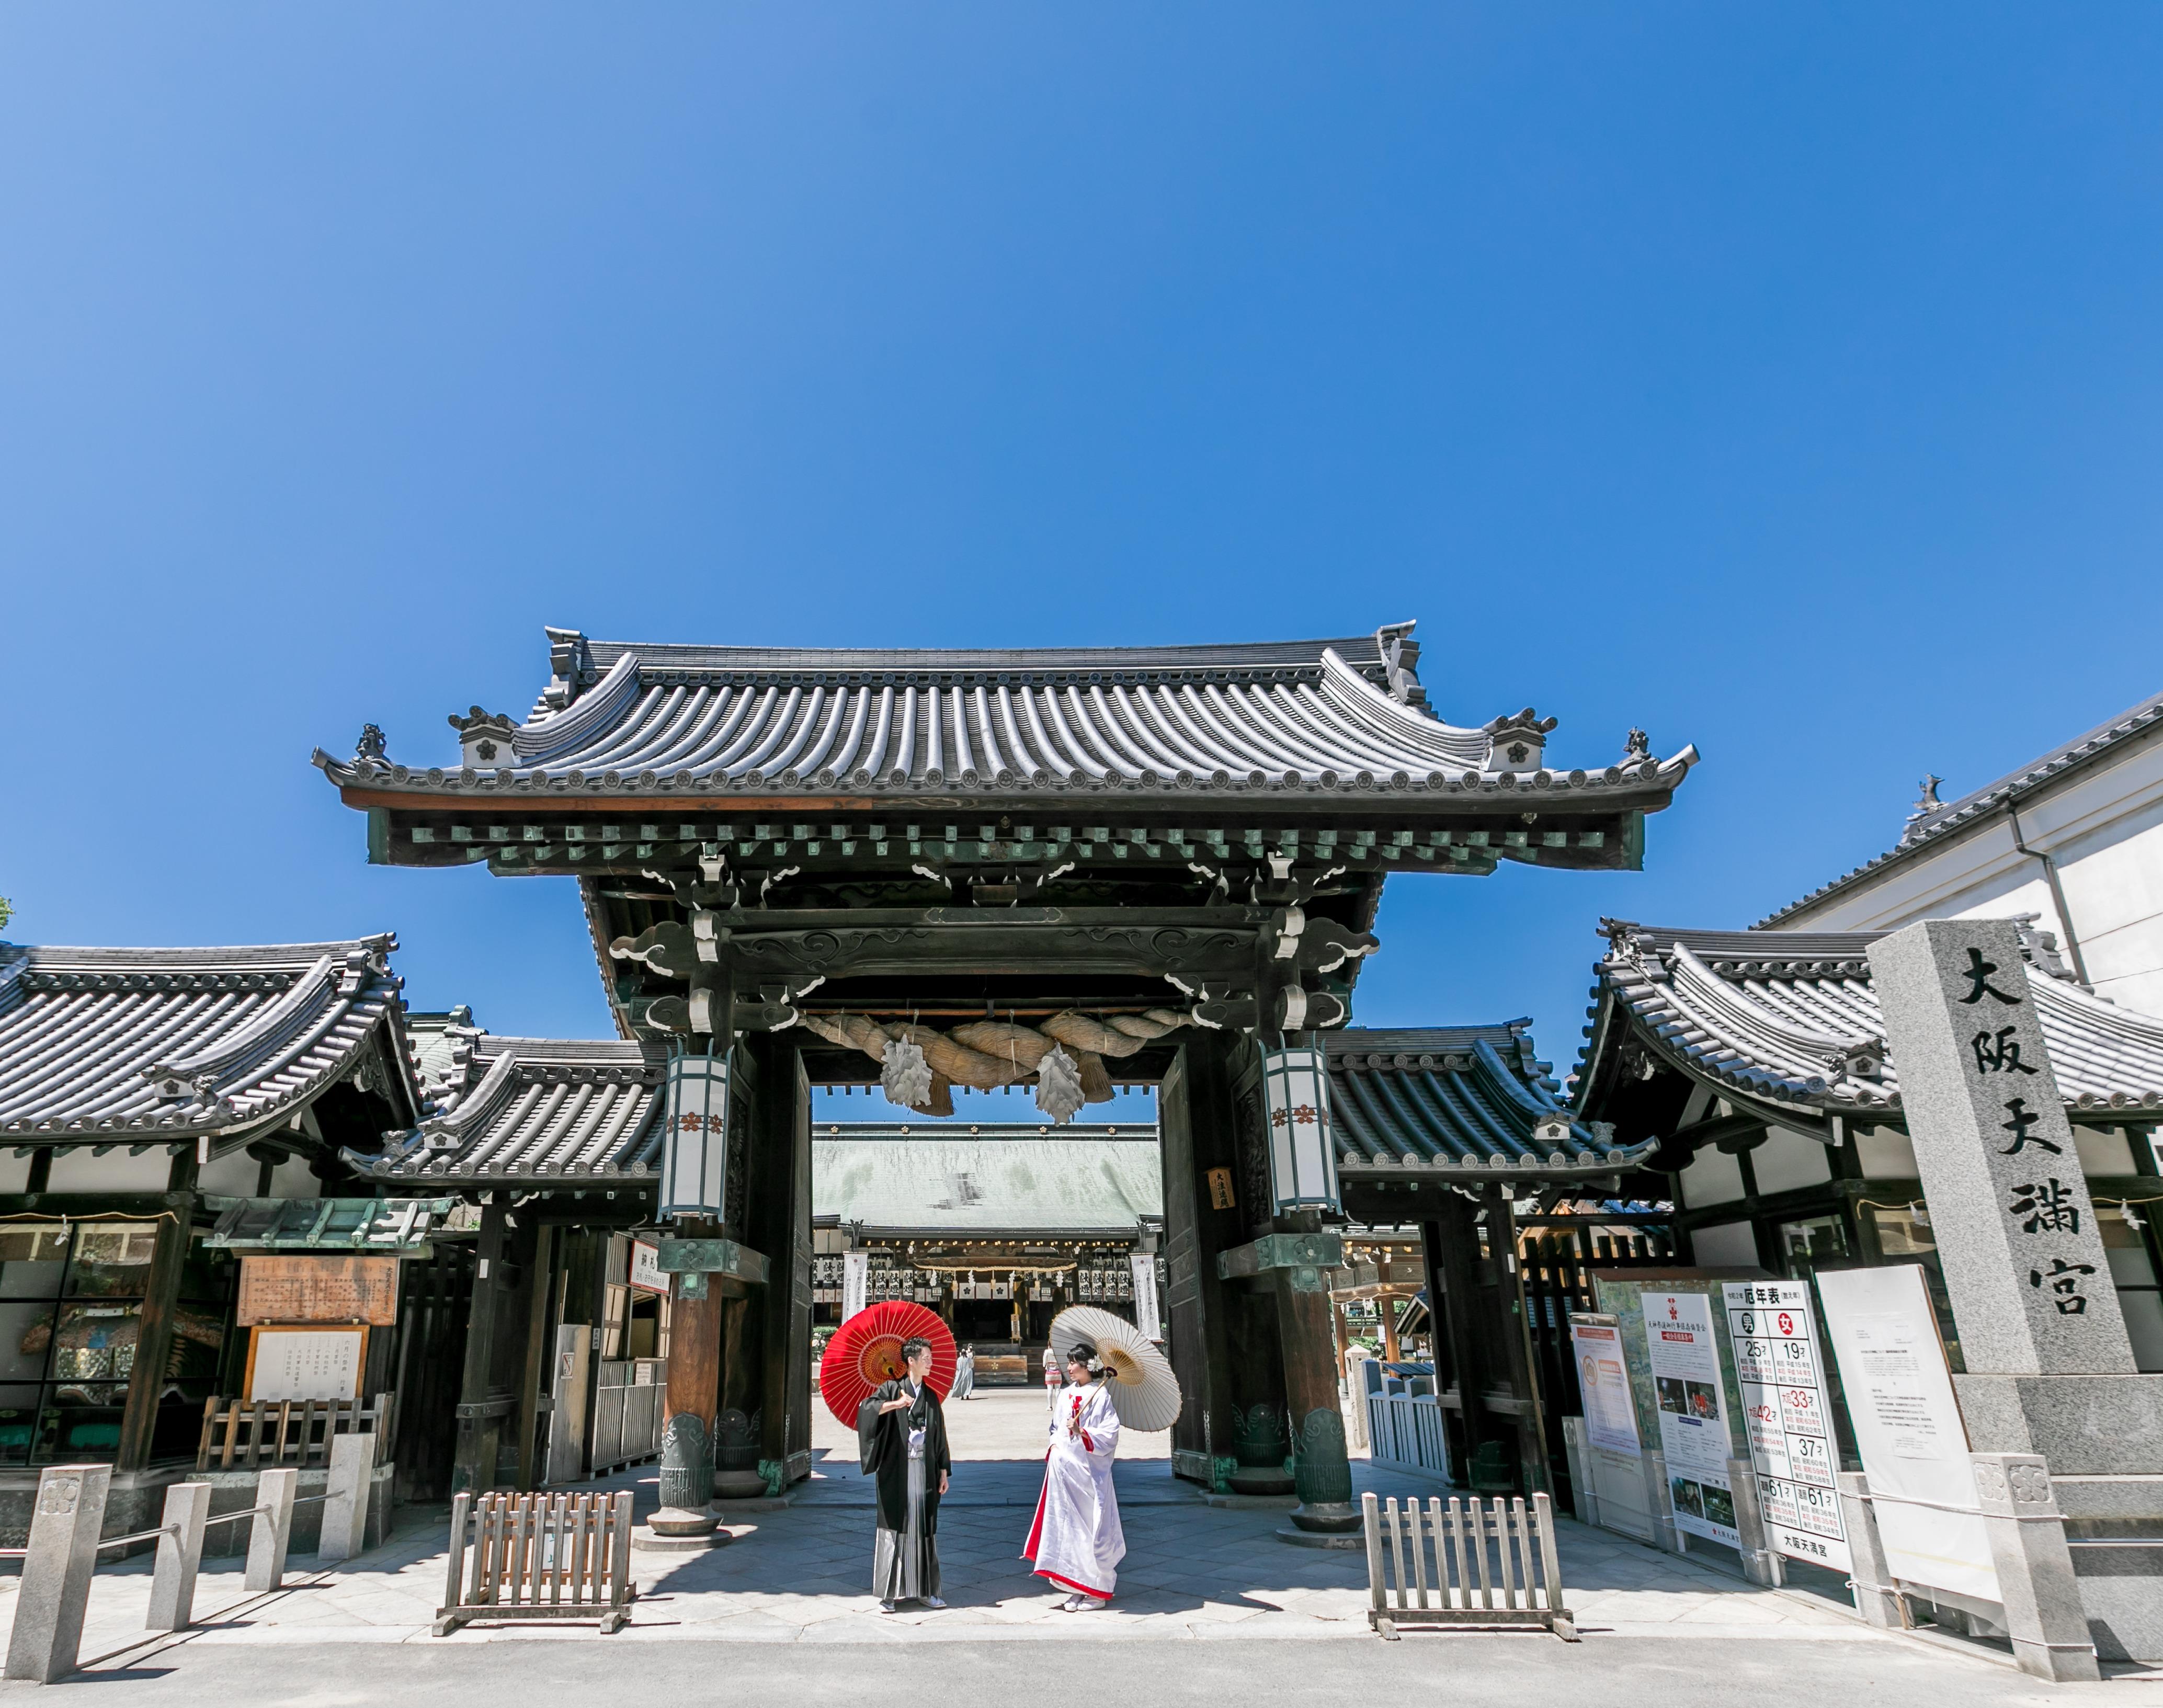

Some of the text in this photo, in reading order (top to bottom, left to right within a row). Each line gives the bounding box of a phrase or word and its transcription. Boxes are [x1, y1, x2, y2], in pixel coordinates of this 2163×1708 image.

[1957, 947, 2096, 1315] 大阪天満宮
[1744, 1288, 1780, 1304] 厄年表
[1743, 1315, 1754, 1330] 男
[1779, 1315, 1792, 1331] 女
[1784, 1534, 1827, 1557] 大阪天満宮
